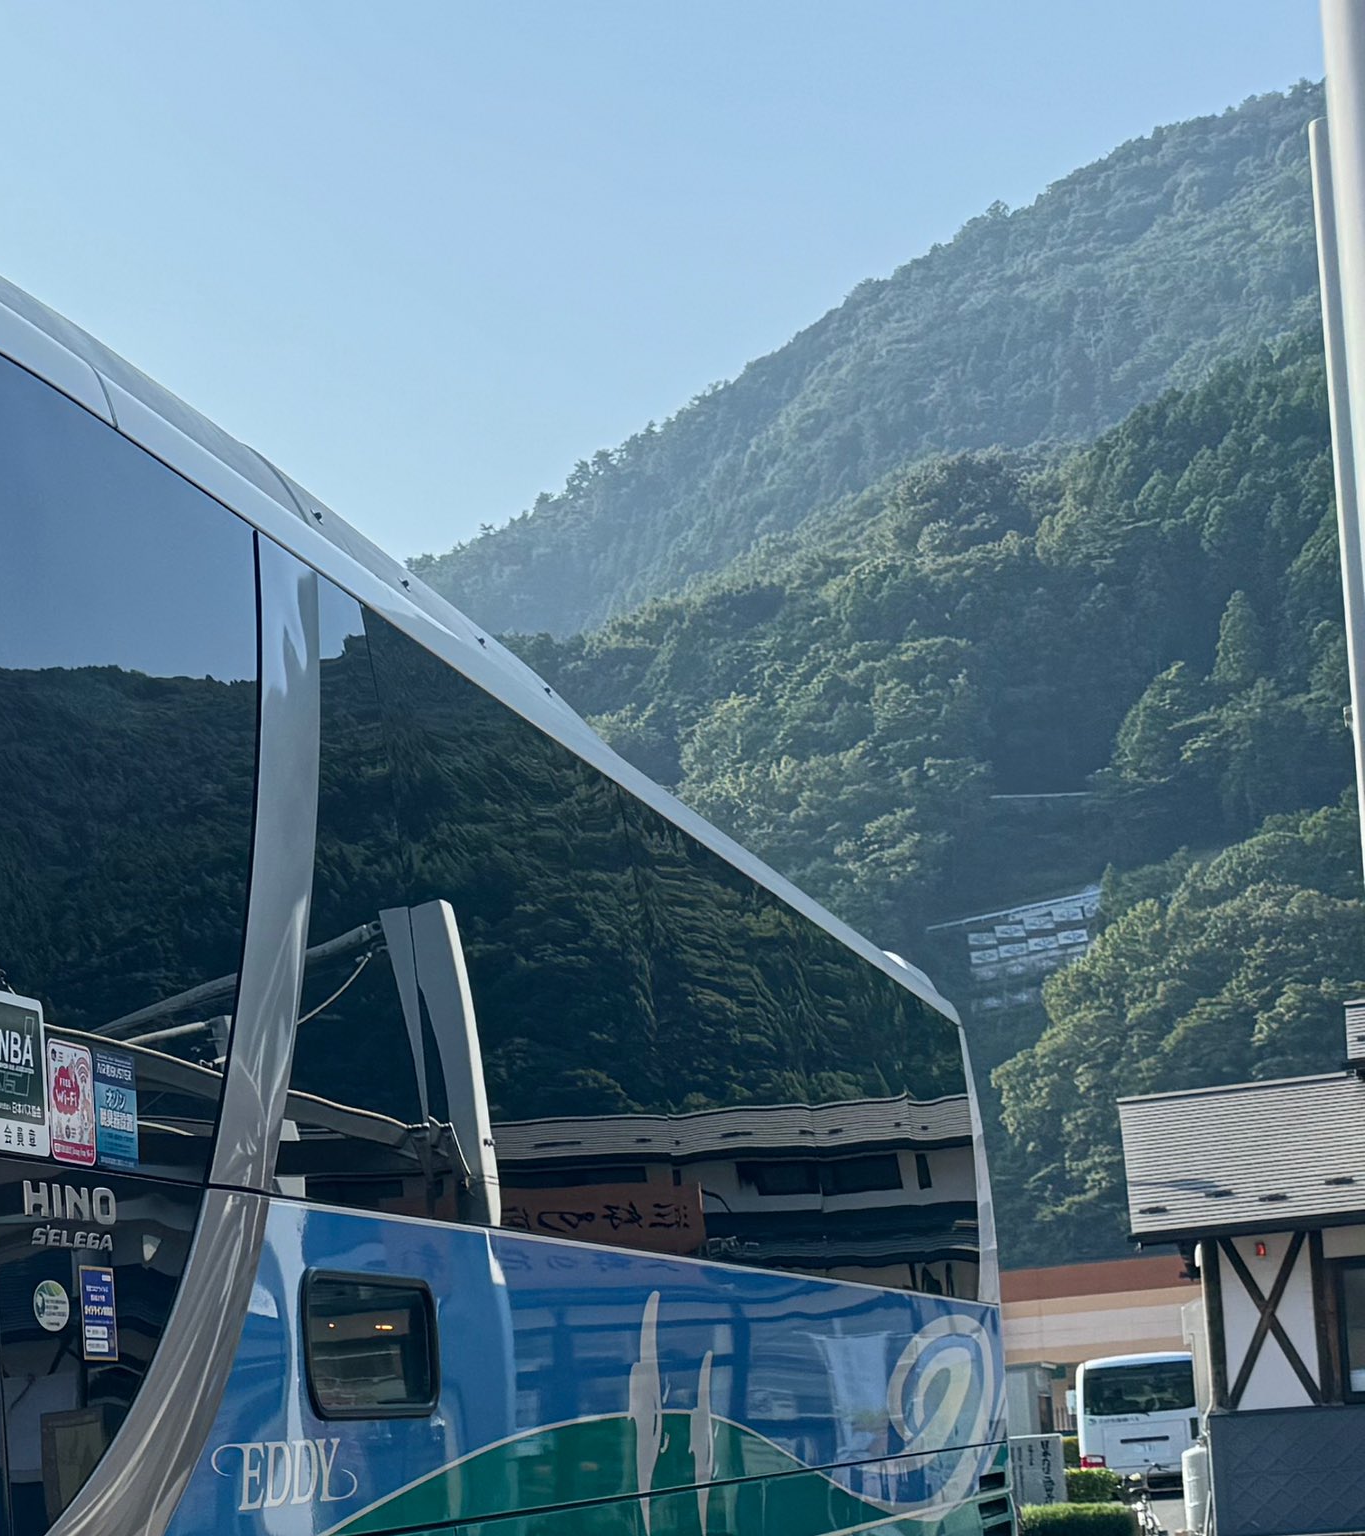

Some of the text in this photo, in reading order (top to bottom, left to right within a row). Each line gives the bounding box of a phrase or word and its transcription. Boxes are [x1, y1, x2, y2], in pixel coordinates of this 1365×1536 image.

[56, 1088, 77, 1107] Wi-Fi
[23, 1180, 117, 1225] HINO
[237, 1438, 342, 1511] EDDY
